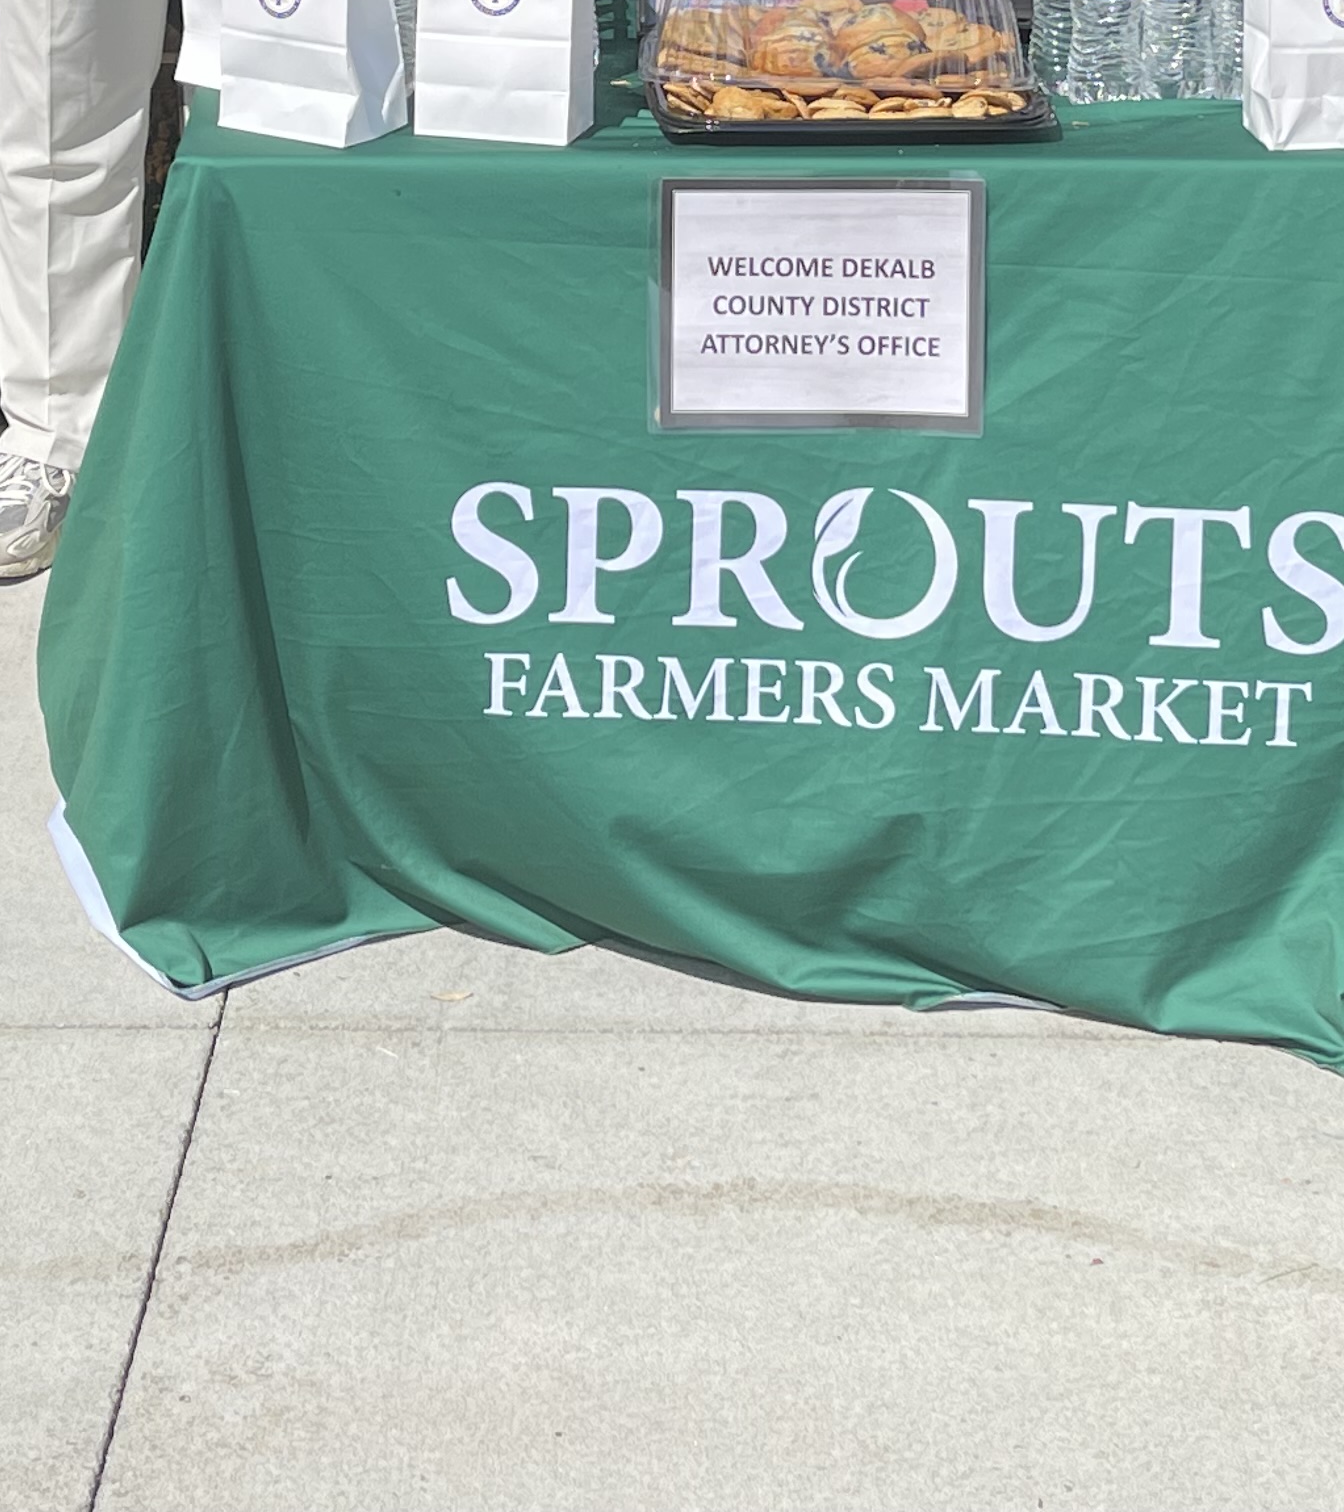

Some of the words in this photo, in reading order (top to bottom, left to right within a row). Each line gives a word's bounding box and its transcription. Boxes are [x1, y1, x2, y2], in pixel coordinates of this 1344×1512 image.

[707, 256, 834, 278] WELCOME
[842, 258, 936, 280] DEKALB
[712, 295, 816, 316] COUNTY
[822, 296, 931, 319] DISTRICT
[700, 333, 850, 356] ATTORNEY'S
[857, 335, 941, 357] OFFICE
[482, 651, 896, 730] FARMERS
[918, 666, 1314, 749] MARKET
